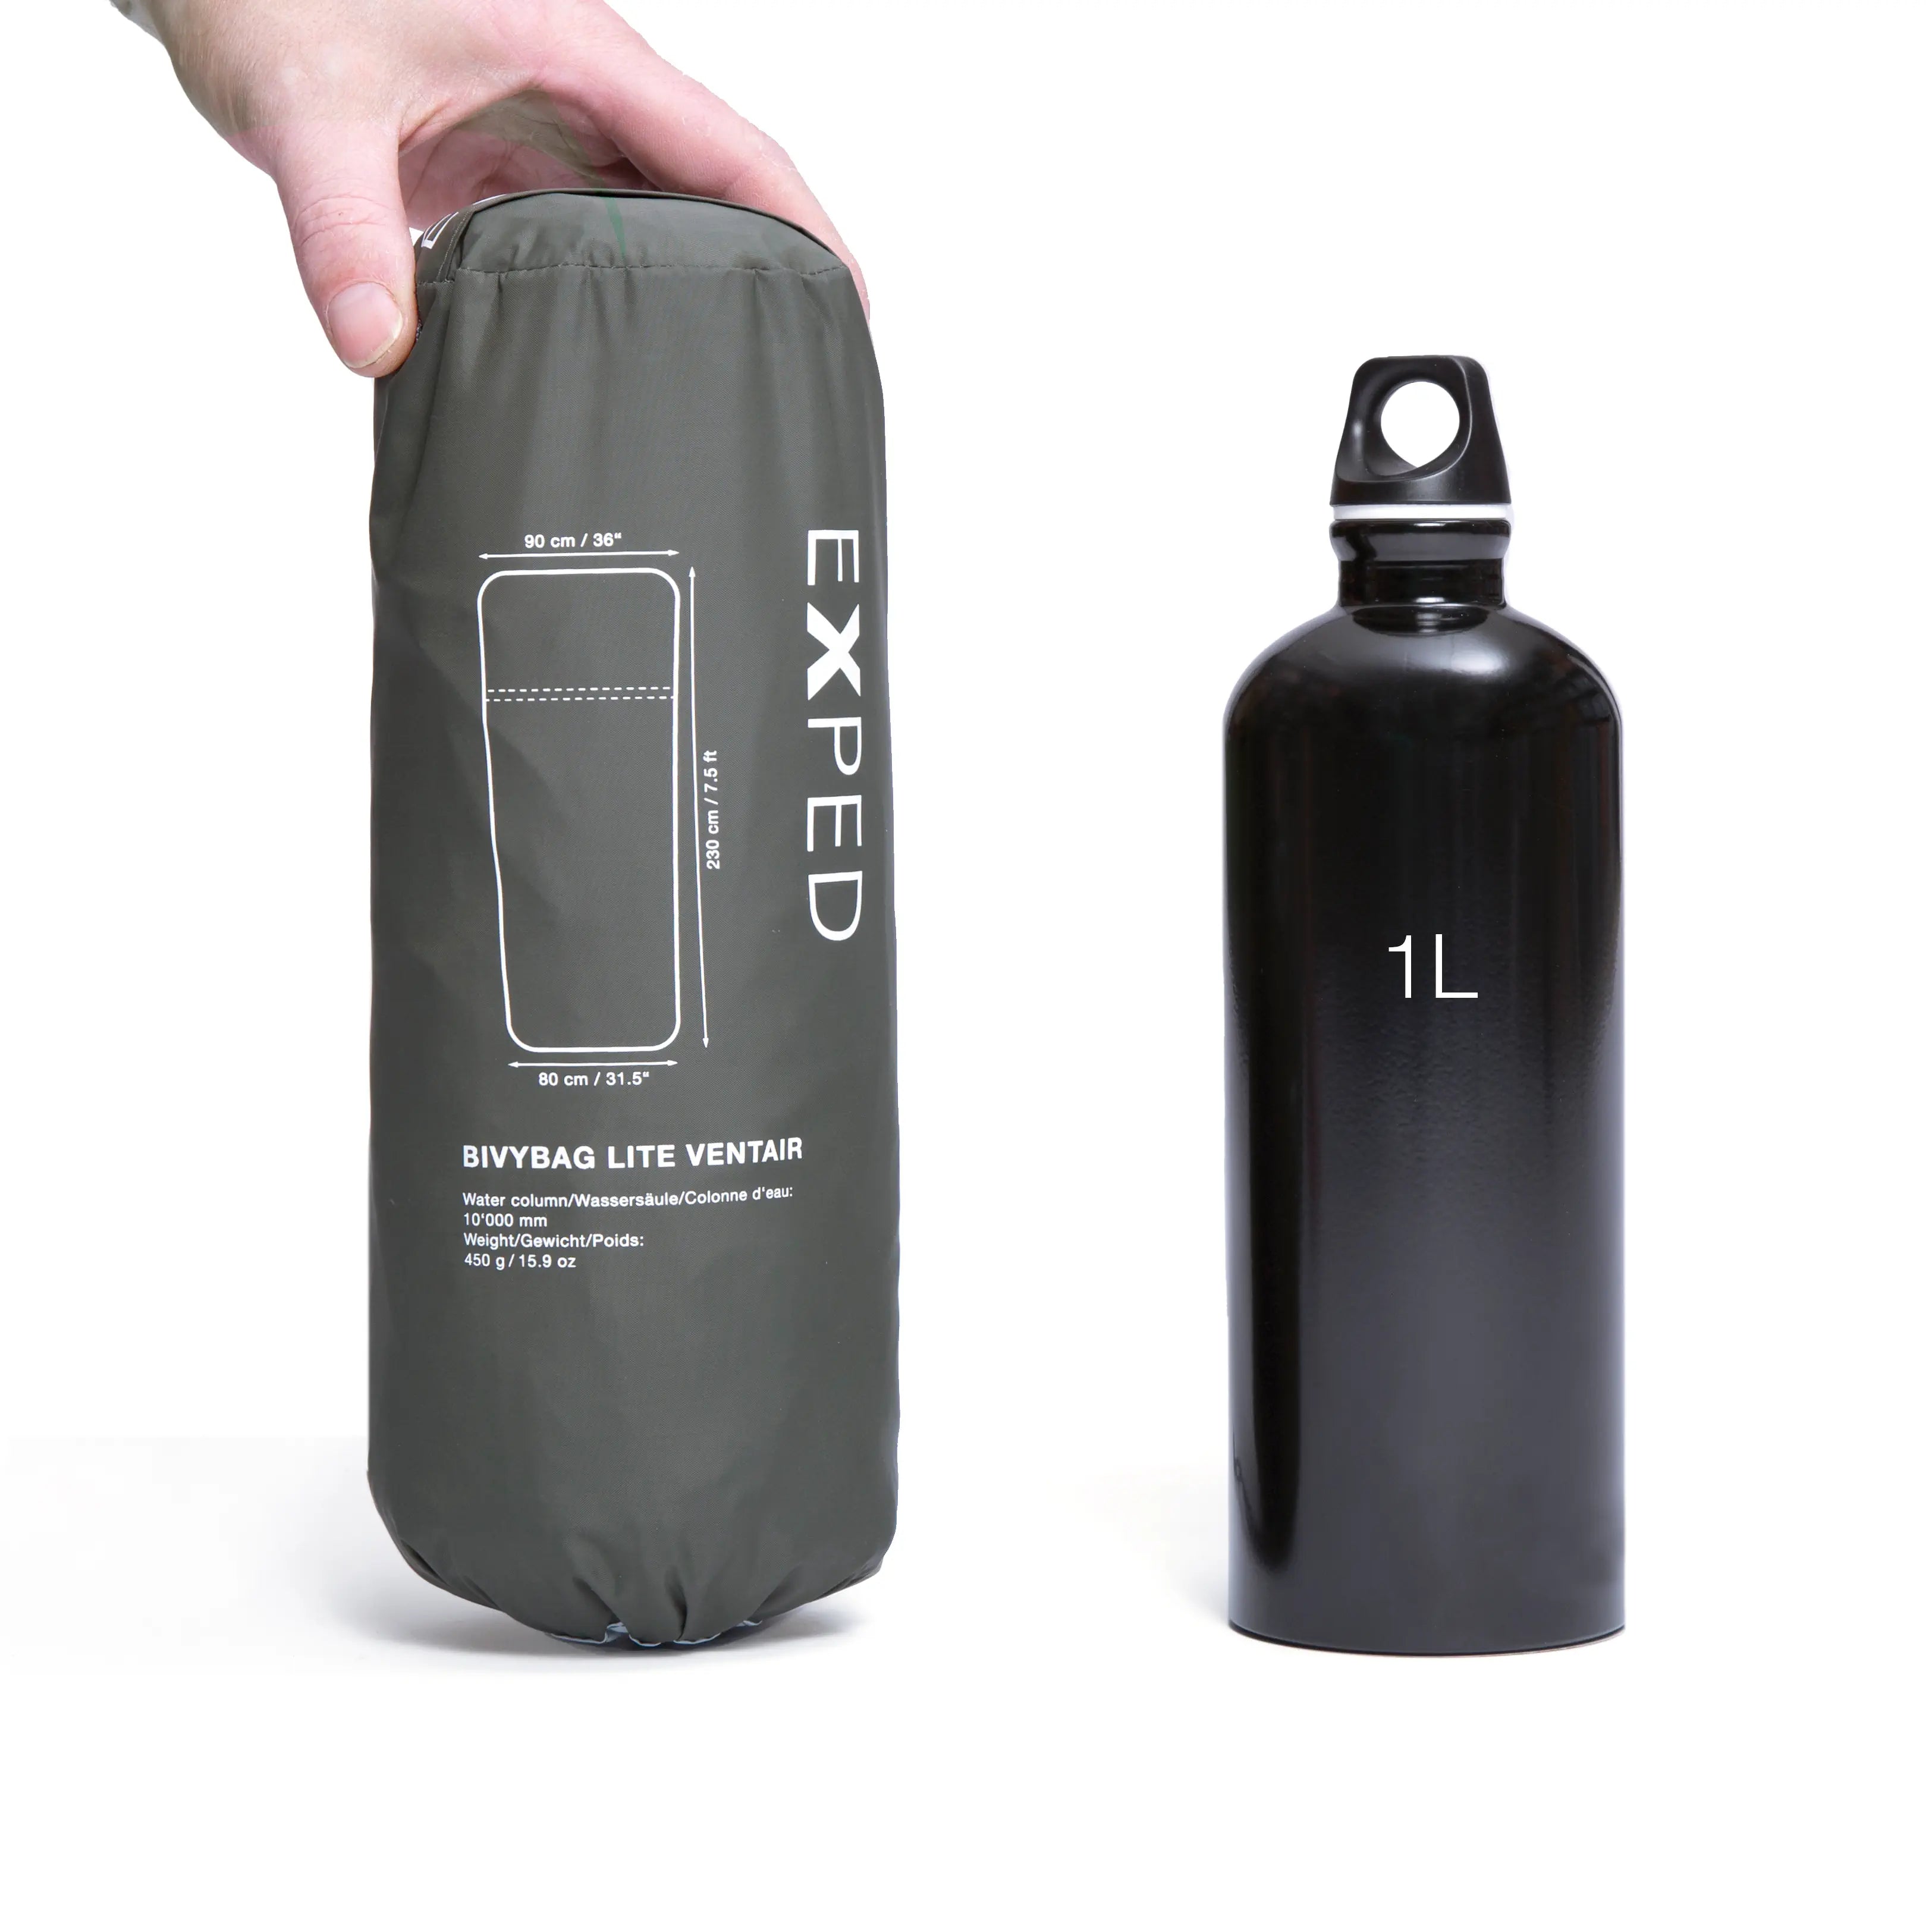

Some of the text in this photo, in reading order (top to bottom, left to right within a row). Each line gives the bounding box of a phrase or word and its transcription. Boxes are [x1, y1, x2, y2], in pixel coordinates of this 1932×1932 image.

[524, 533, 545, 549] 90
[550, 536, 576, 548] cm
[580, 533, 589, 548] /
[806, 529, 863, 942] EXPED
[702, 750, 721, 870] 230 cm / 7.5 ft
[538, 1072, 558, 1086] 80
[564, 1075, 589, 1086] cm
[593, 1071, 601, 1086] /
[463, 1136, 803, 1170] BIVYBAG LITE VENTAIR
[462, 1192, 506, 1207] Water
[519, 1216, 548, 1227] mm
[463, 1232, 644, 1251] Weight/Gewicht/Poids:
[464, 1252, 491, 1267] 450
[508, 1254, 515, 1268] /
[519, 1254, 552, 1268] 15.9
[557, 1256, 577, 1268] oz
